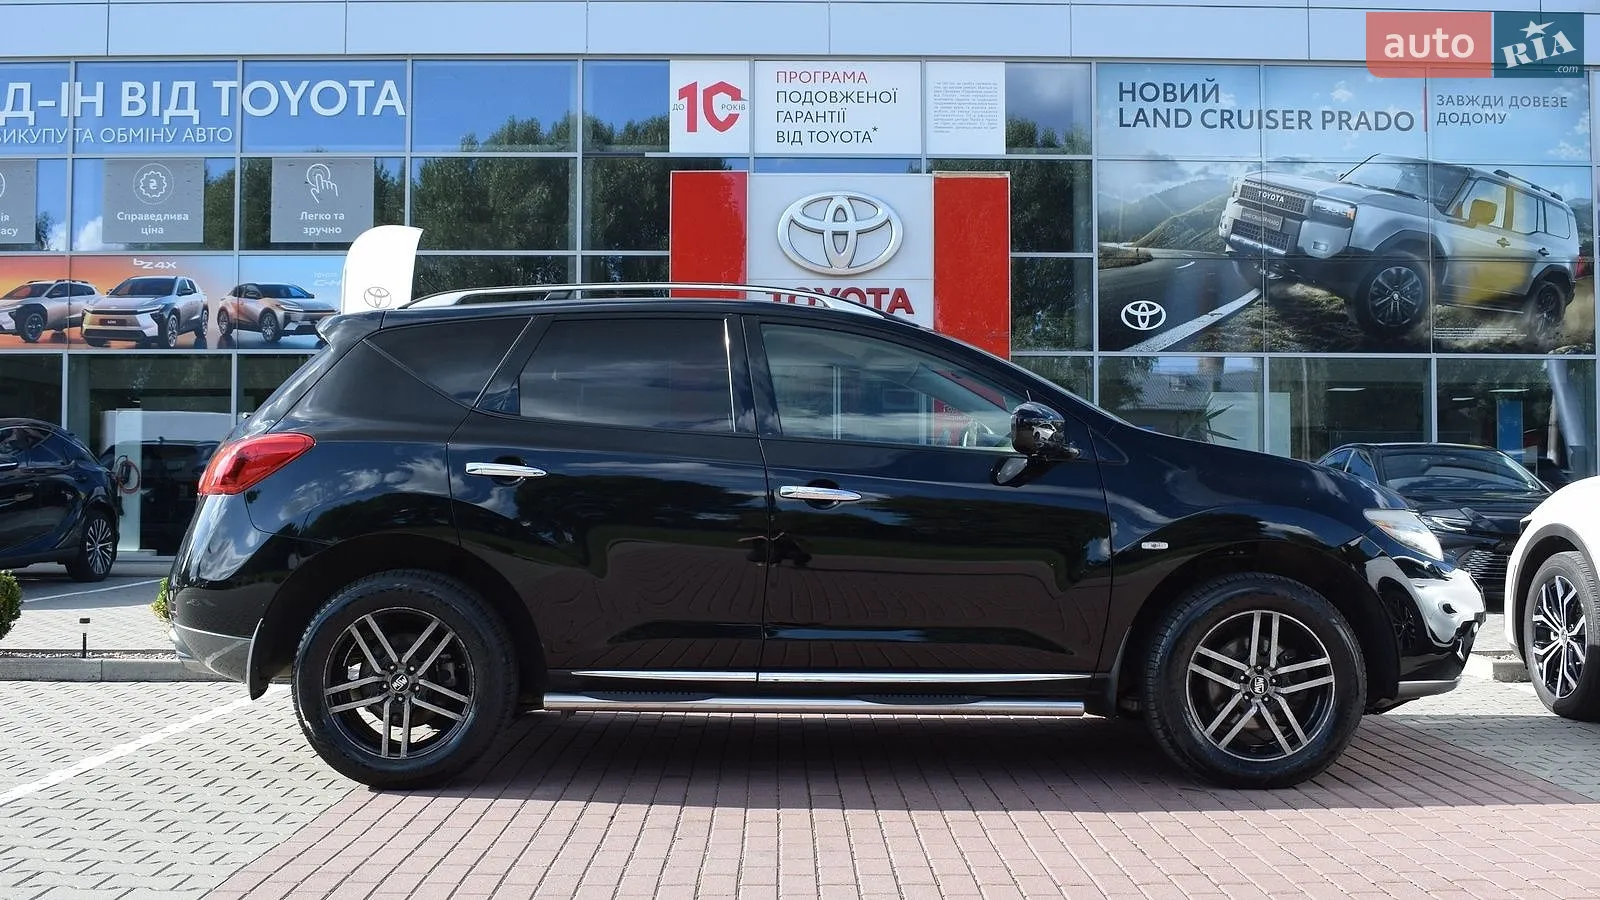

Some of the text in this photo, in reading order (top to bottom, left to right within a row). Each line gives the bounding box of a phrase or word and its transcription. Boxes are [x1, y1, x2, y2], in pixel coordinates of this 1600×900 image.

[776, 71, 868, 83] ПРОГРАМА
[776, 88, 898, 105] ПОДОВЖЕНОЇ
[1119, 78, 1220, 103] НОВИЙ
[121, 81, 200, 125] ВІД
[212, 80, 406, 117] TOYOTA
[1436, 95, 1568, 109] ЗАВЖДИ ДОВЕЗЕ
[776, 108, 847, 123] ГАРАНТІЇ
[1119, 108, 1415, 132] LAND CRUISER PRADO
[1436, 113, 1507, 126] ДОДОМУ
[0, 127, 233, 144] ИКУПУ ТА ОБМІНУ АВТО
[776, 131, 803, 145] ВІД
[1258, 190, 1285, 203] TOYOTA
[116, 211, 189, 222] Справедлива
[300, 211, 345, 221] Легко та
[141, 225, 164, 235] ціна
[303, 226, 342, 236] зручно
